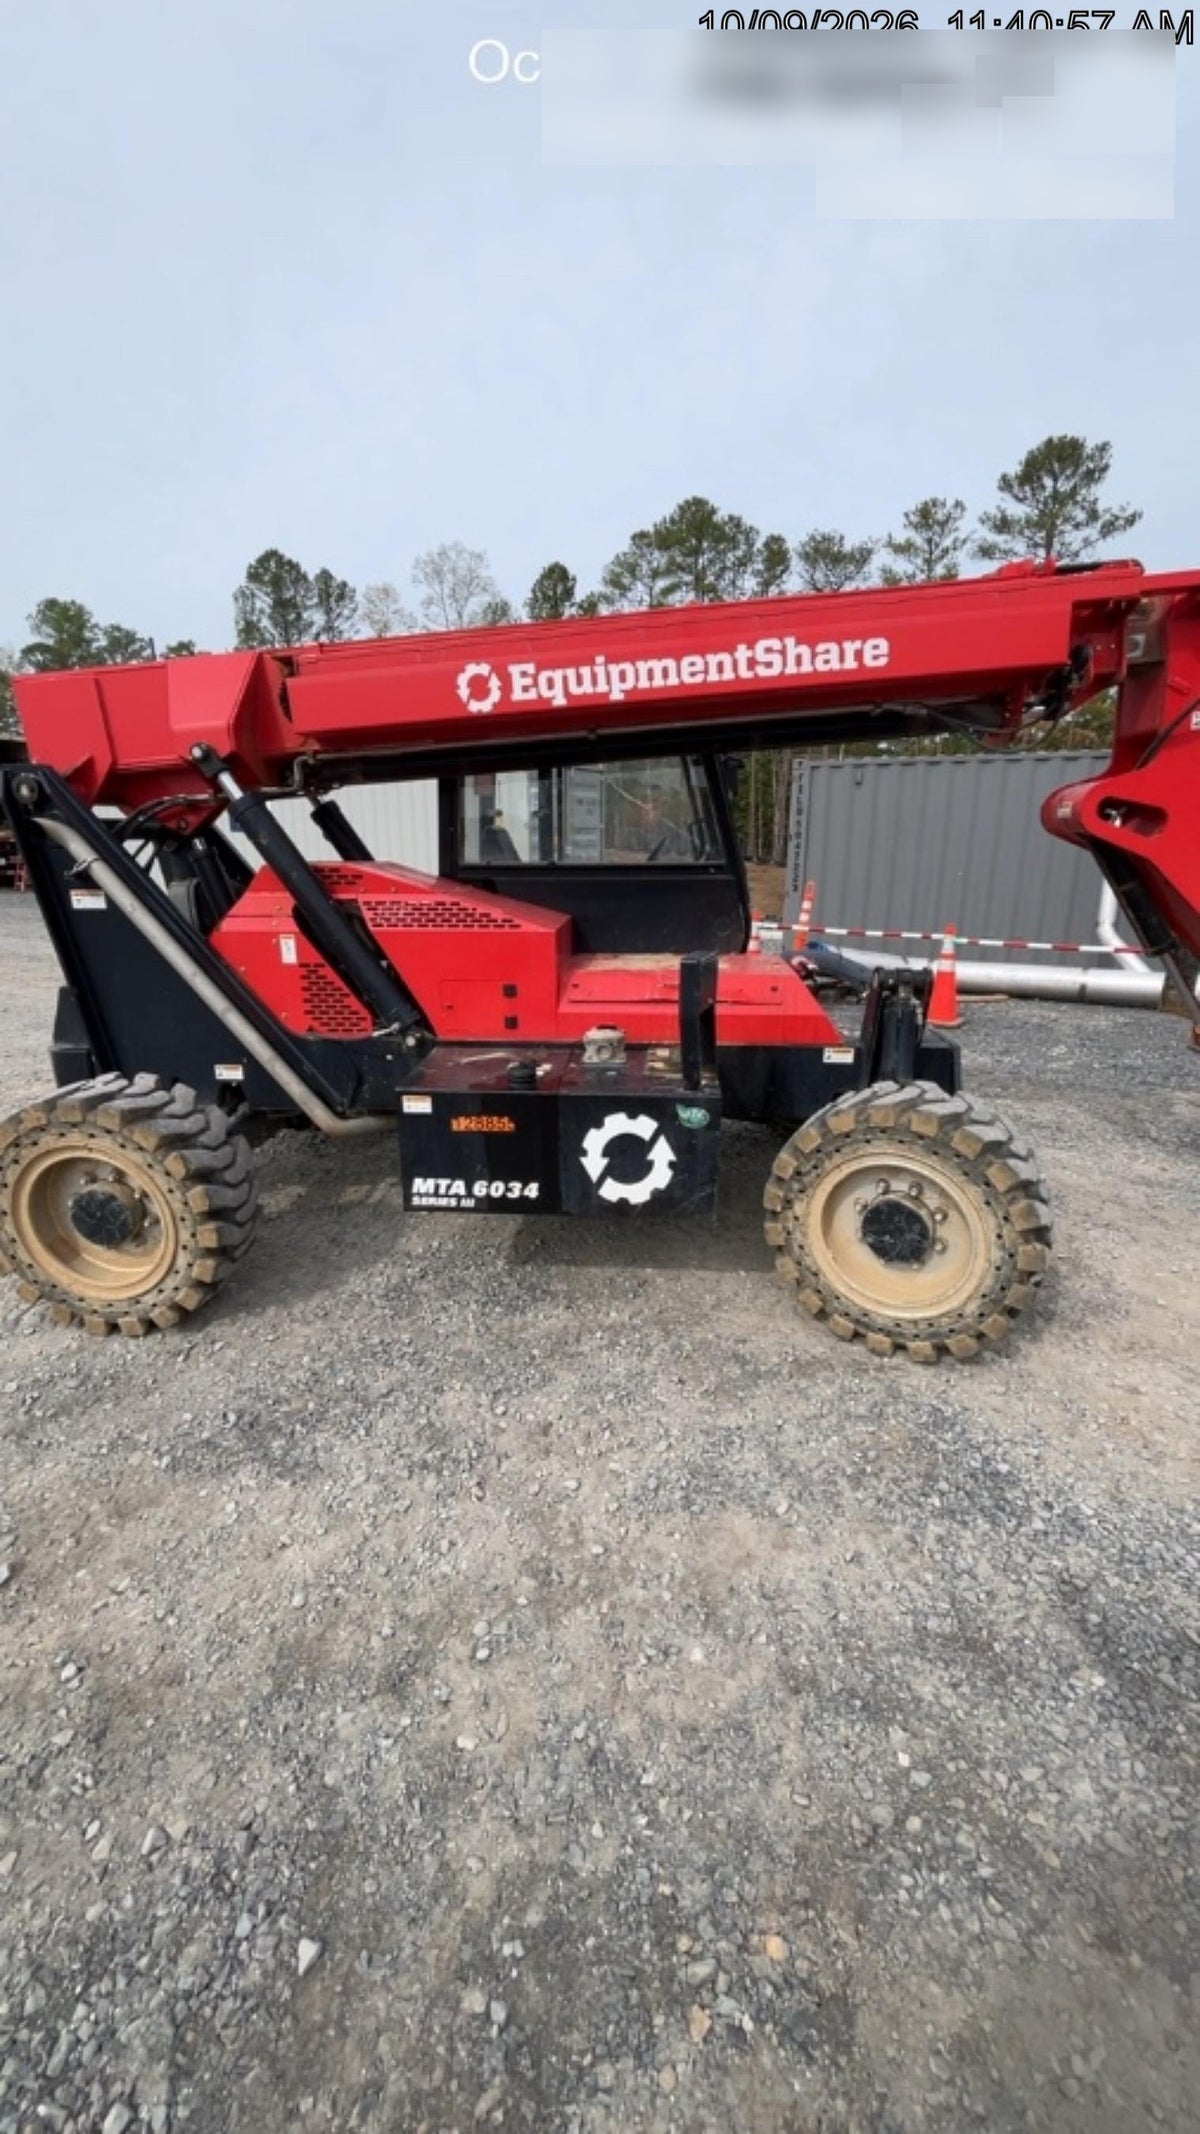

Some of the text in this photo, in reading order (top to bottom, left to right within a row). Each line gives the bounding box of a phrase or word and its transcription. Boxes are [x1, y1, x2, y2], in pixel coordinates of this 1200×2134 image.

[508, 636, 890, 707] EquipmentShare
[411, 1177, 540, 1198] MTA 6034
[411, 1195, 459, 1208] SERIES
